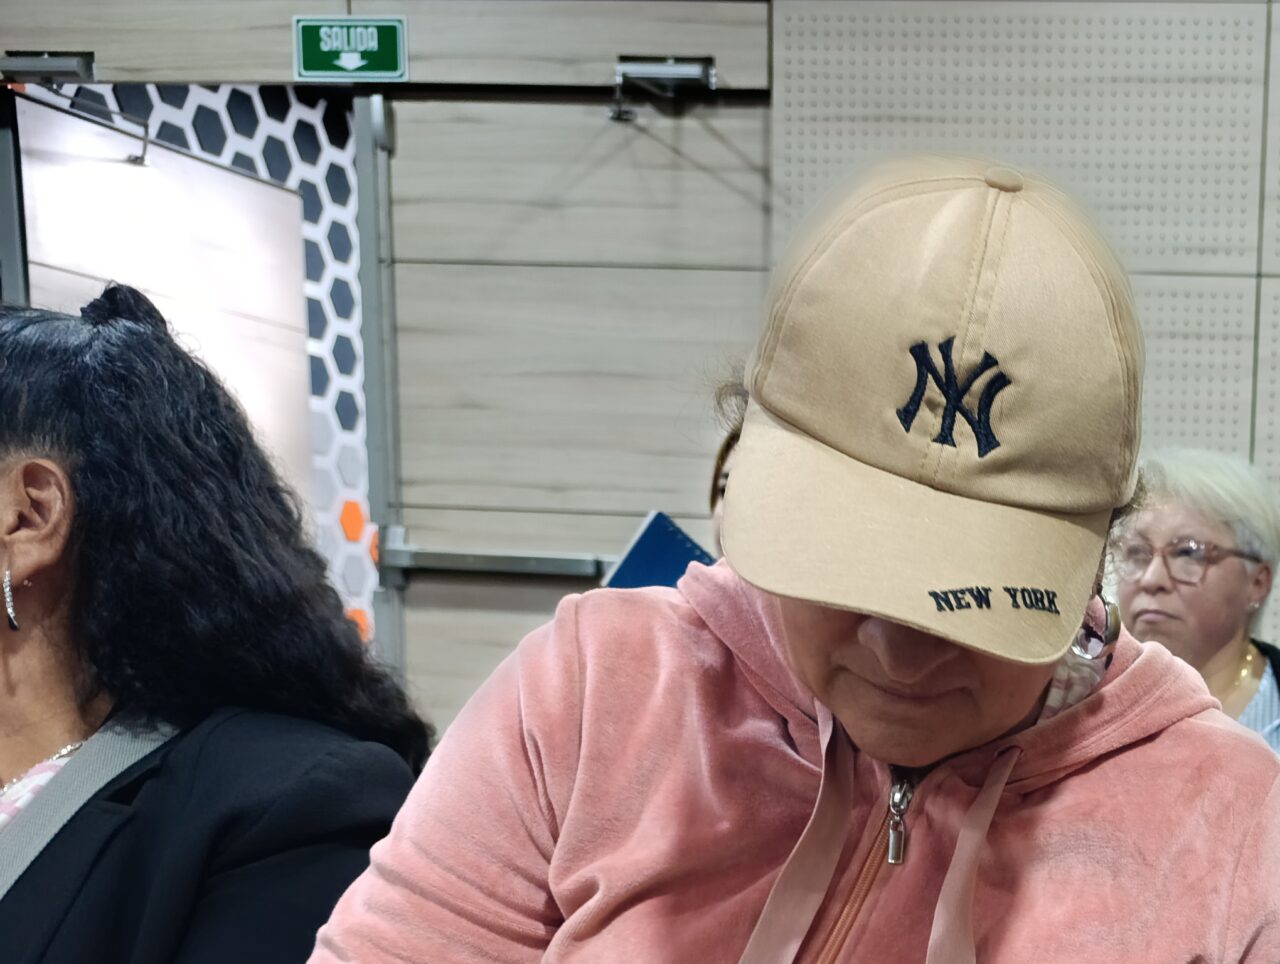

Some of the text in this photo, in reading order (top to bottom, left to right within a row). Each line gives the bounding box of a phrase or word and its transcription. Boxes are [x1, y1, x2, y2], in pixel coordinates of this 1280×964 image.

[319, 26, 378, 52] SALIDA
[896, 336, 1012, 458] NY
[928, 586, 1061, 615] NEW YORK
